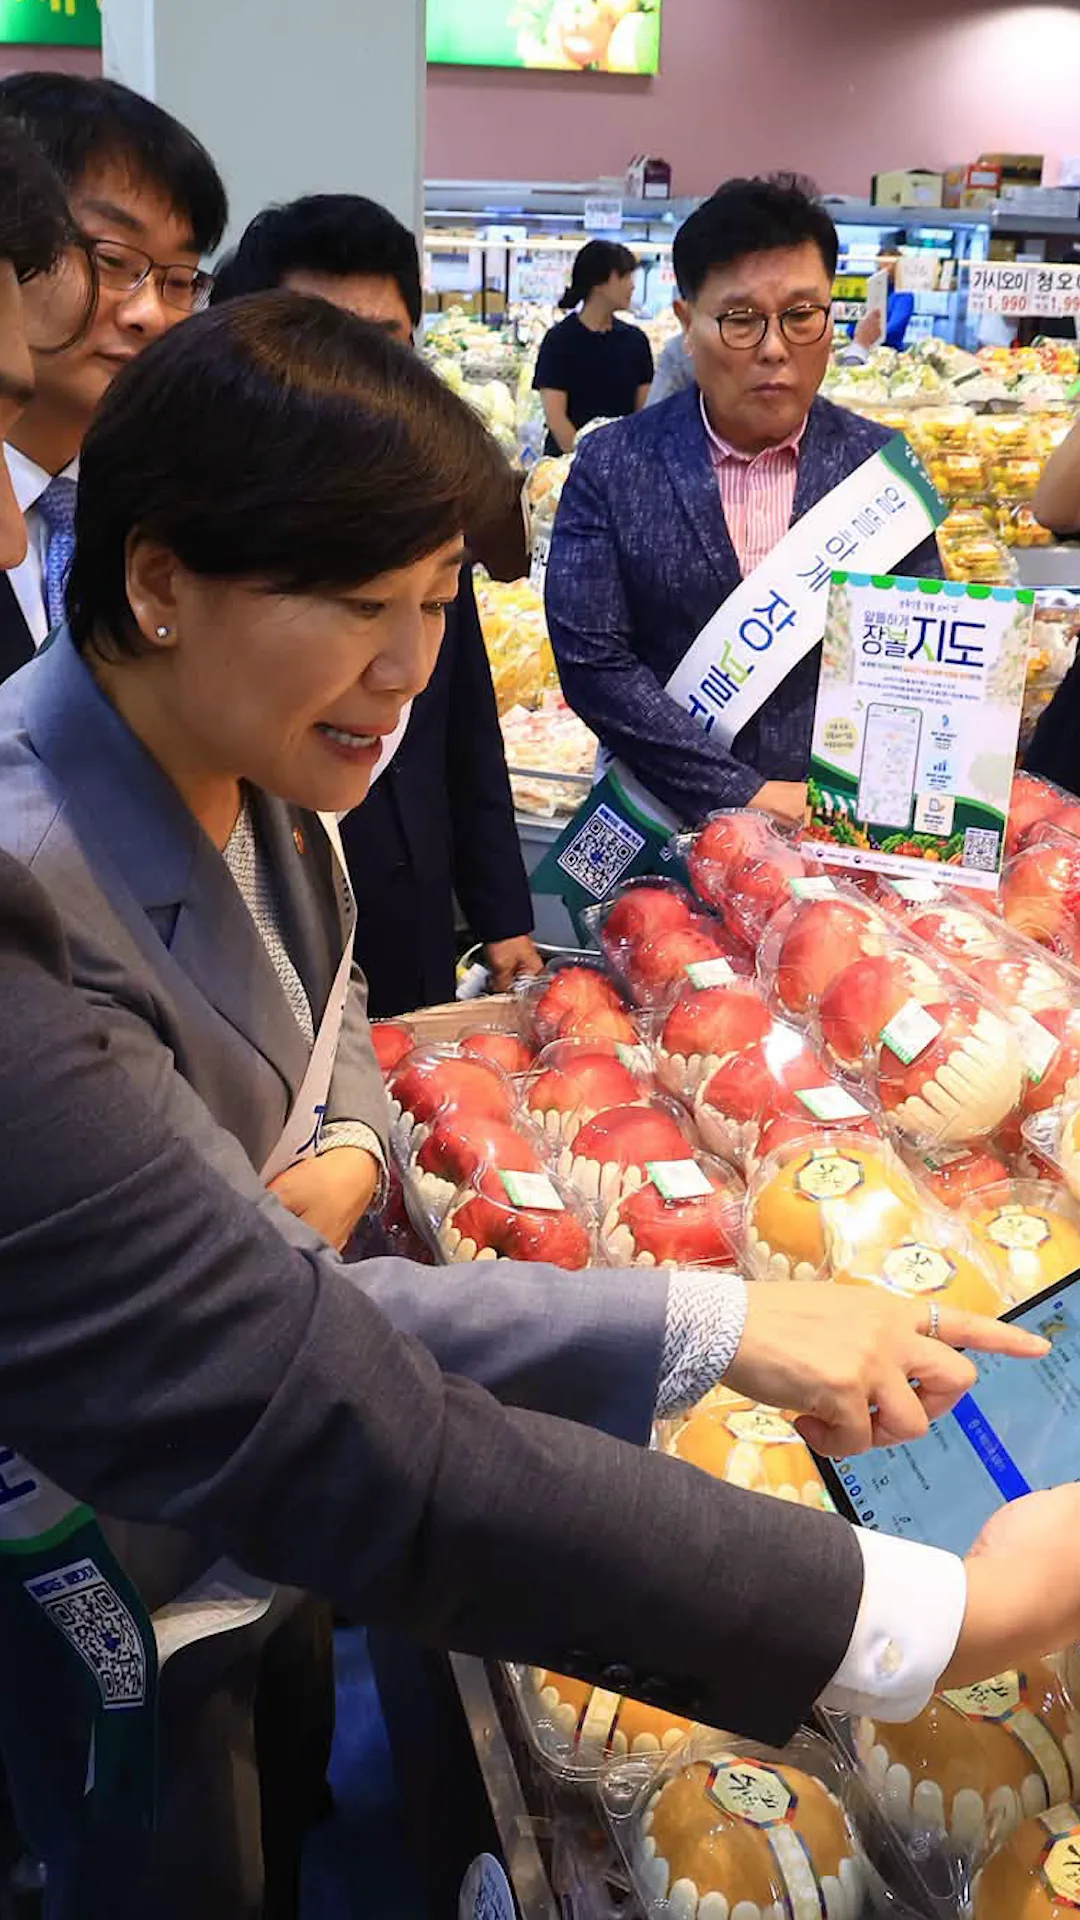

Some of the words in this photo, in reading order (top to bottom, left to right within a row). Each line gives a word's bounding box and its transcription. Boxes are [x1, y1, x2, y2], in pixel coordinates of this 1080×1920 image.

[974, 268, 1029, 292] 가시오이
[987, 295, 1028, 312] 1,990
[797, 486, 907, 593] 알뜰하게
[863, 610, 910, 627] 알뜰하게
